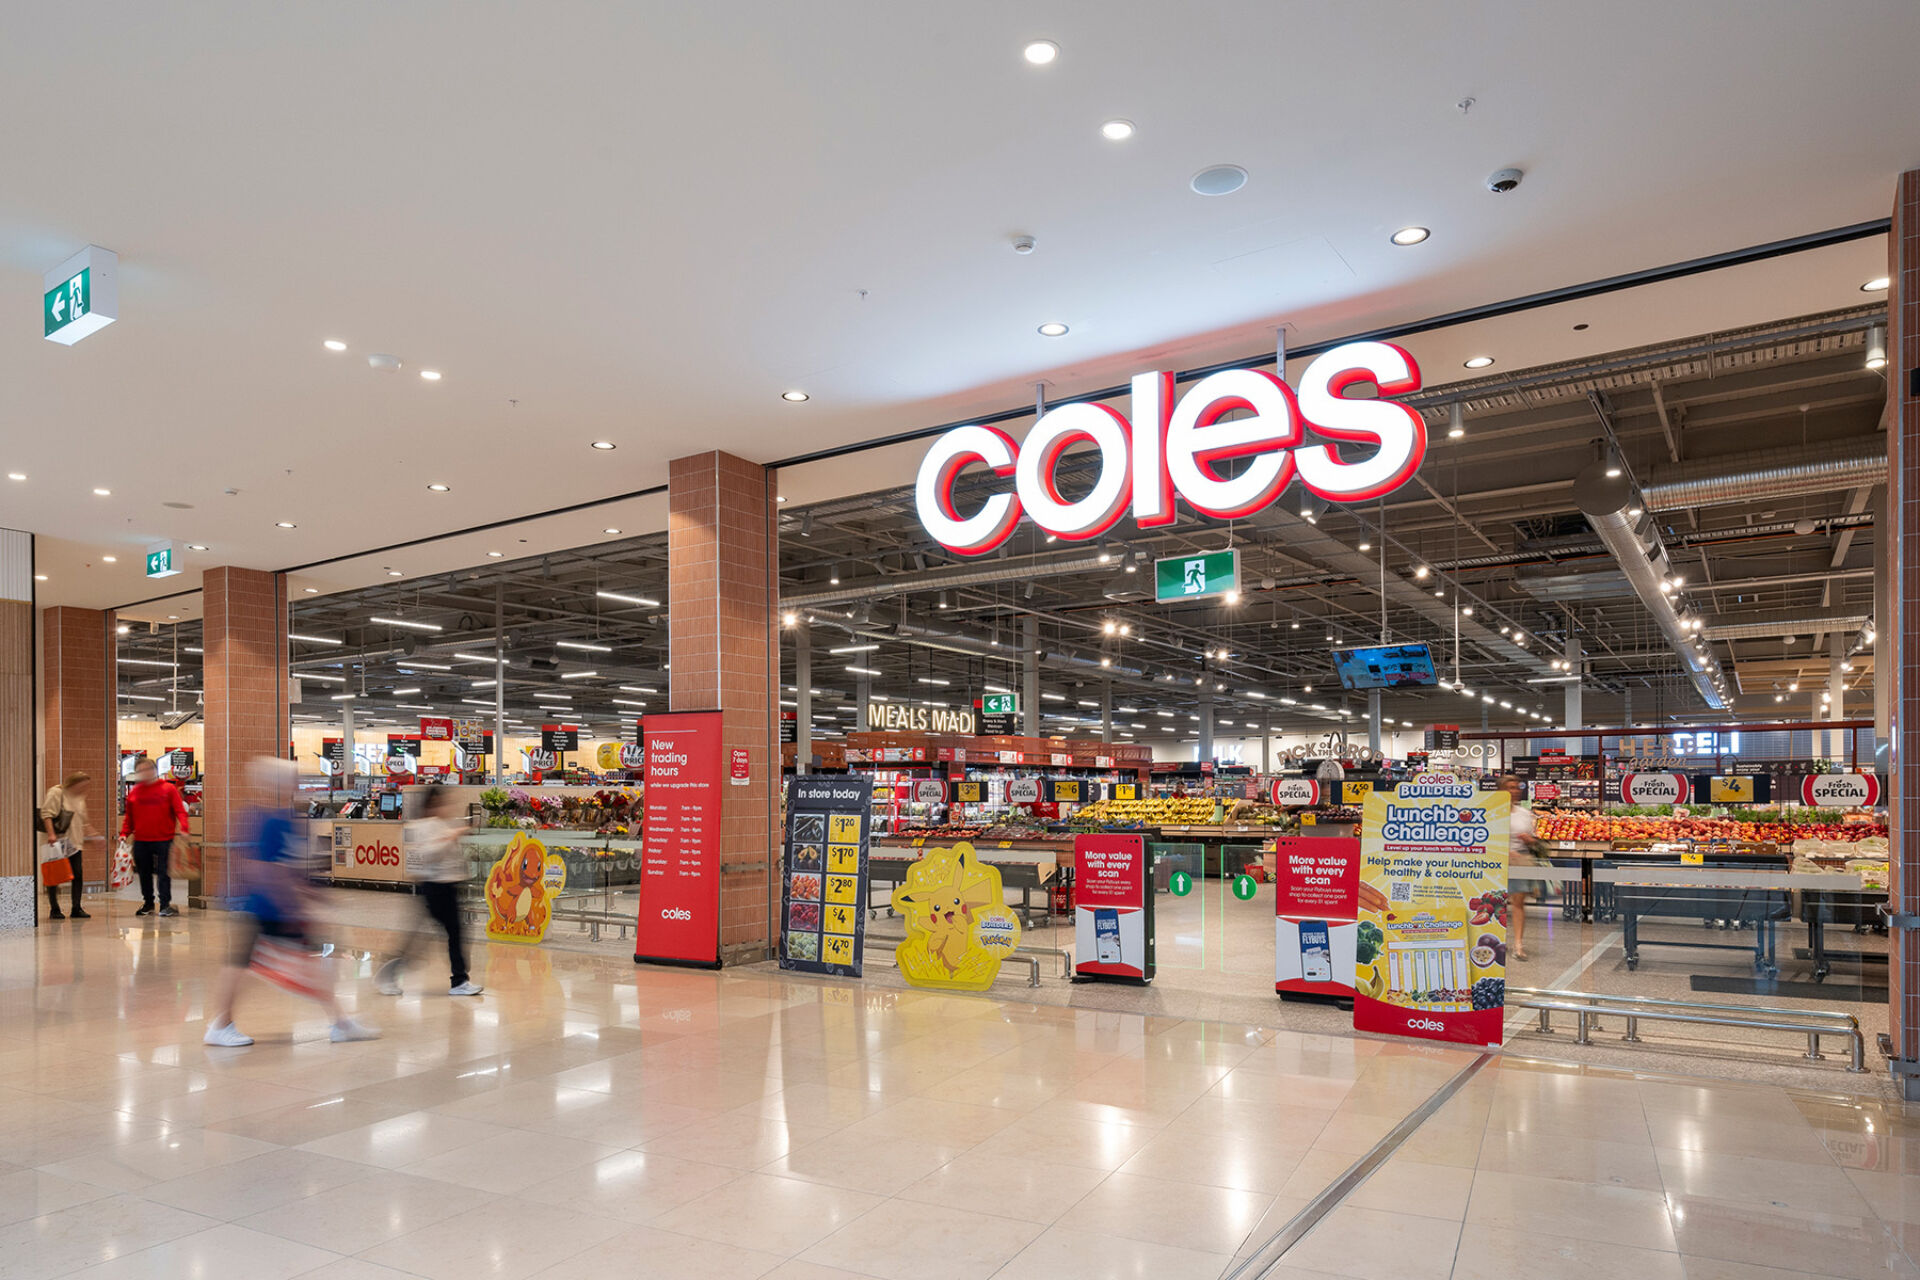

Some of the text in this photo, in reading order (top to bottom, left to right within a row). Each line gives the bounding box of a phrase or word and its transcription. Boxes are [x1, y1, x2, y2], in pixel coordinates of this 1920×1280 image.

[915, 341, 1429, 557] coles
[868, 703, 976, 733] MEALS MAD
[651, 739, 674, 750] New
[1619, 738, 1698, 757] HERB
[651, 752, 688, 766] trading
[1277, 742, 1319, 766] PICK
[1332, 742, 1385, 764] CROP
[650, 765, 679, 776] hours
[1419, 774, 1454, 784] coles
[1722, 778, 1741, 792] $4
[798, 788, 861, 801] In store today
[1011, 789, 1037, 797] SPECIAL
[1056, 784, 1062, 794] 2
[1279, 791, 1311, 799] SPECIAL
[1400, 784, 1473, 798] BUILDERS
[1632, 787, 1677, 796] SPECIAL
[1815, 788, 1866, 797] SPECIAL
[1382, 822, 1489, 847] Challenge
[355, 840, 400, 866] coles
[1084, 851, 1132, 860] More value
[1087, 860, 1130, 871] with every
[1288, 855, 1347, 866] More value
[1367, 856, 1502, 869] Help make your lunchbox
[1098, 870, 1119, 878] scan
[1292, 866, 1345, 878] with every
[1384, 867, 1483, 880] healthy & colourful
[1304, 876, 1331, 885] scan
[661, 907, 691, 920] coles
[833, 908, 846, 923] $4
[981, 921, 1013, 930] BUILDERS
[1423, 920, 1463, 930] Challenge
[1302, 935, 1327, 944] FLYBUYS
[1407, 1017, 1444, 1032] coles
